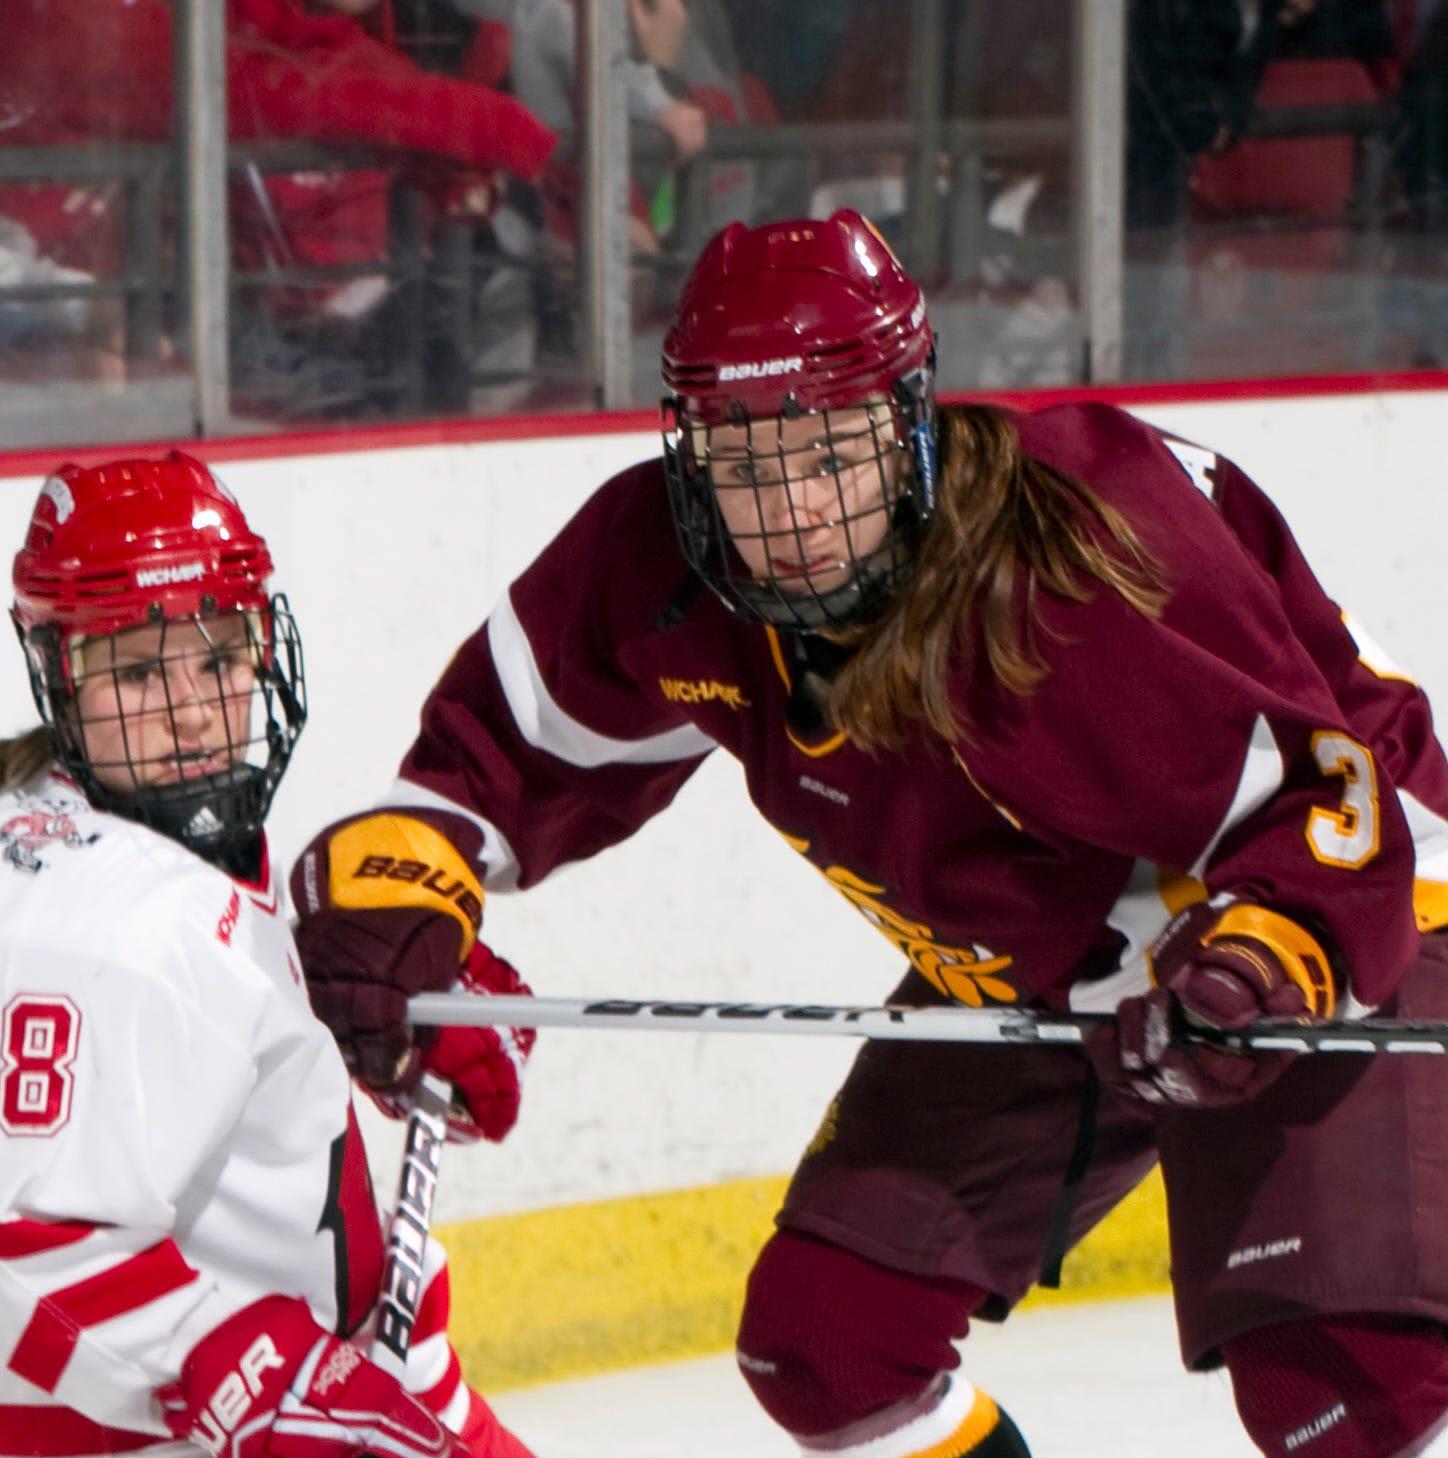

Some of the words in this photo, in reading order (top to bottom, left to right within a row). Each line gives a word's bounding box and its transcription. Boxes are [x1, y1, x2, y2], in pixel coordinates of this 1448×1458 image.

[719, 356, 803, 382] BAUER
[1305, 728, 1380, 871] 3
[1226, 1237, 1302, 1269] BAUER
[1285, 1402, 1348, 1452] BAUER
